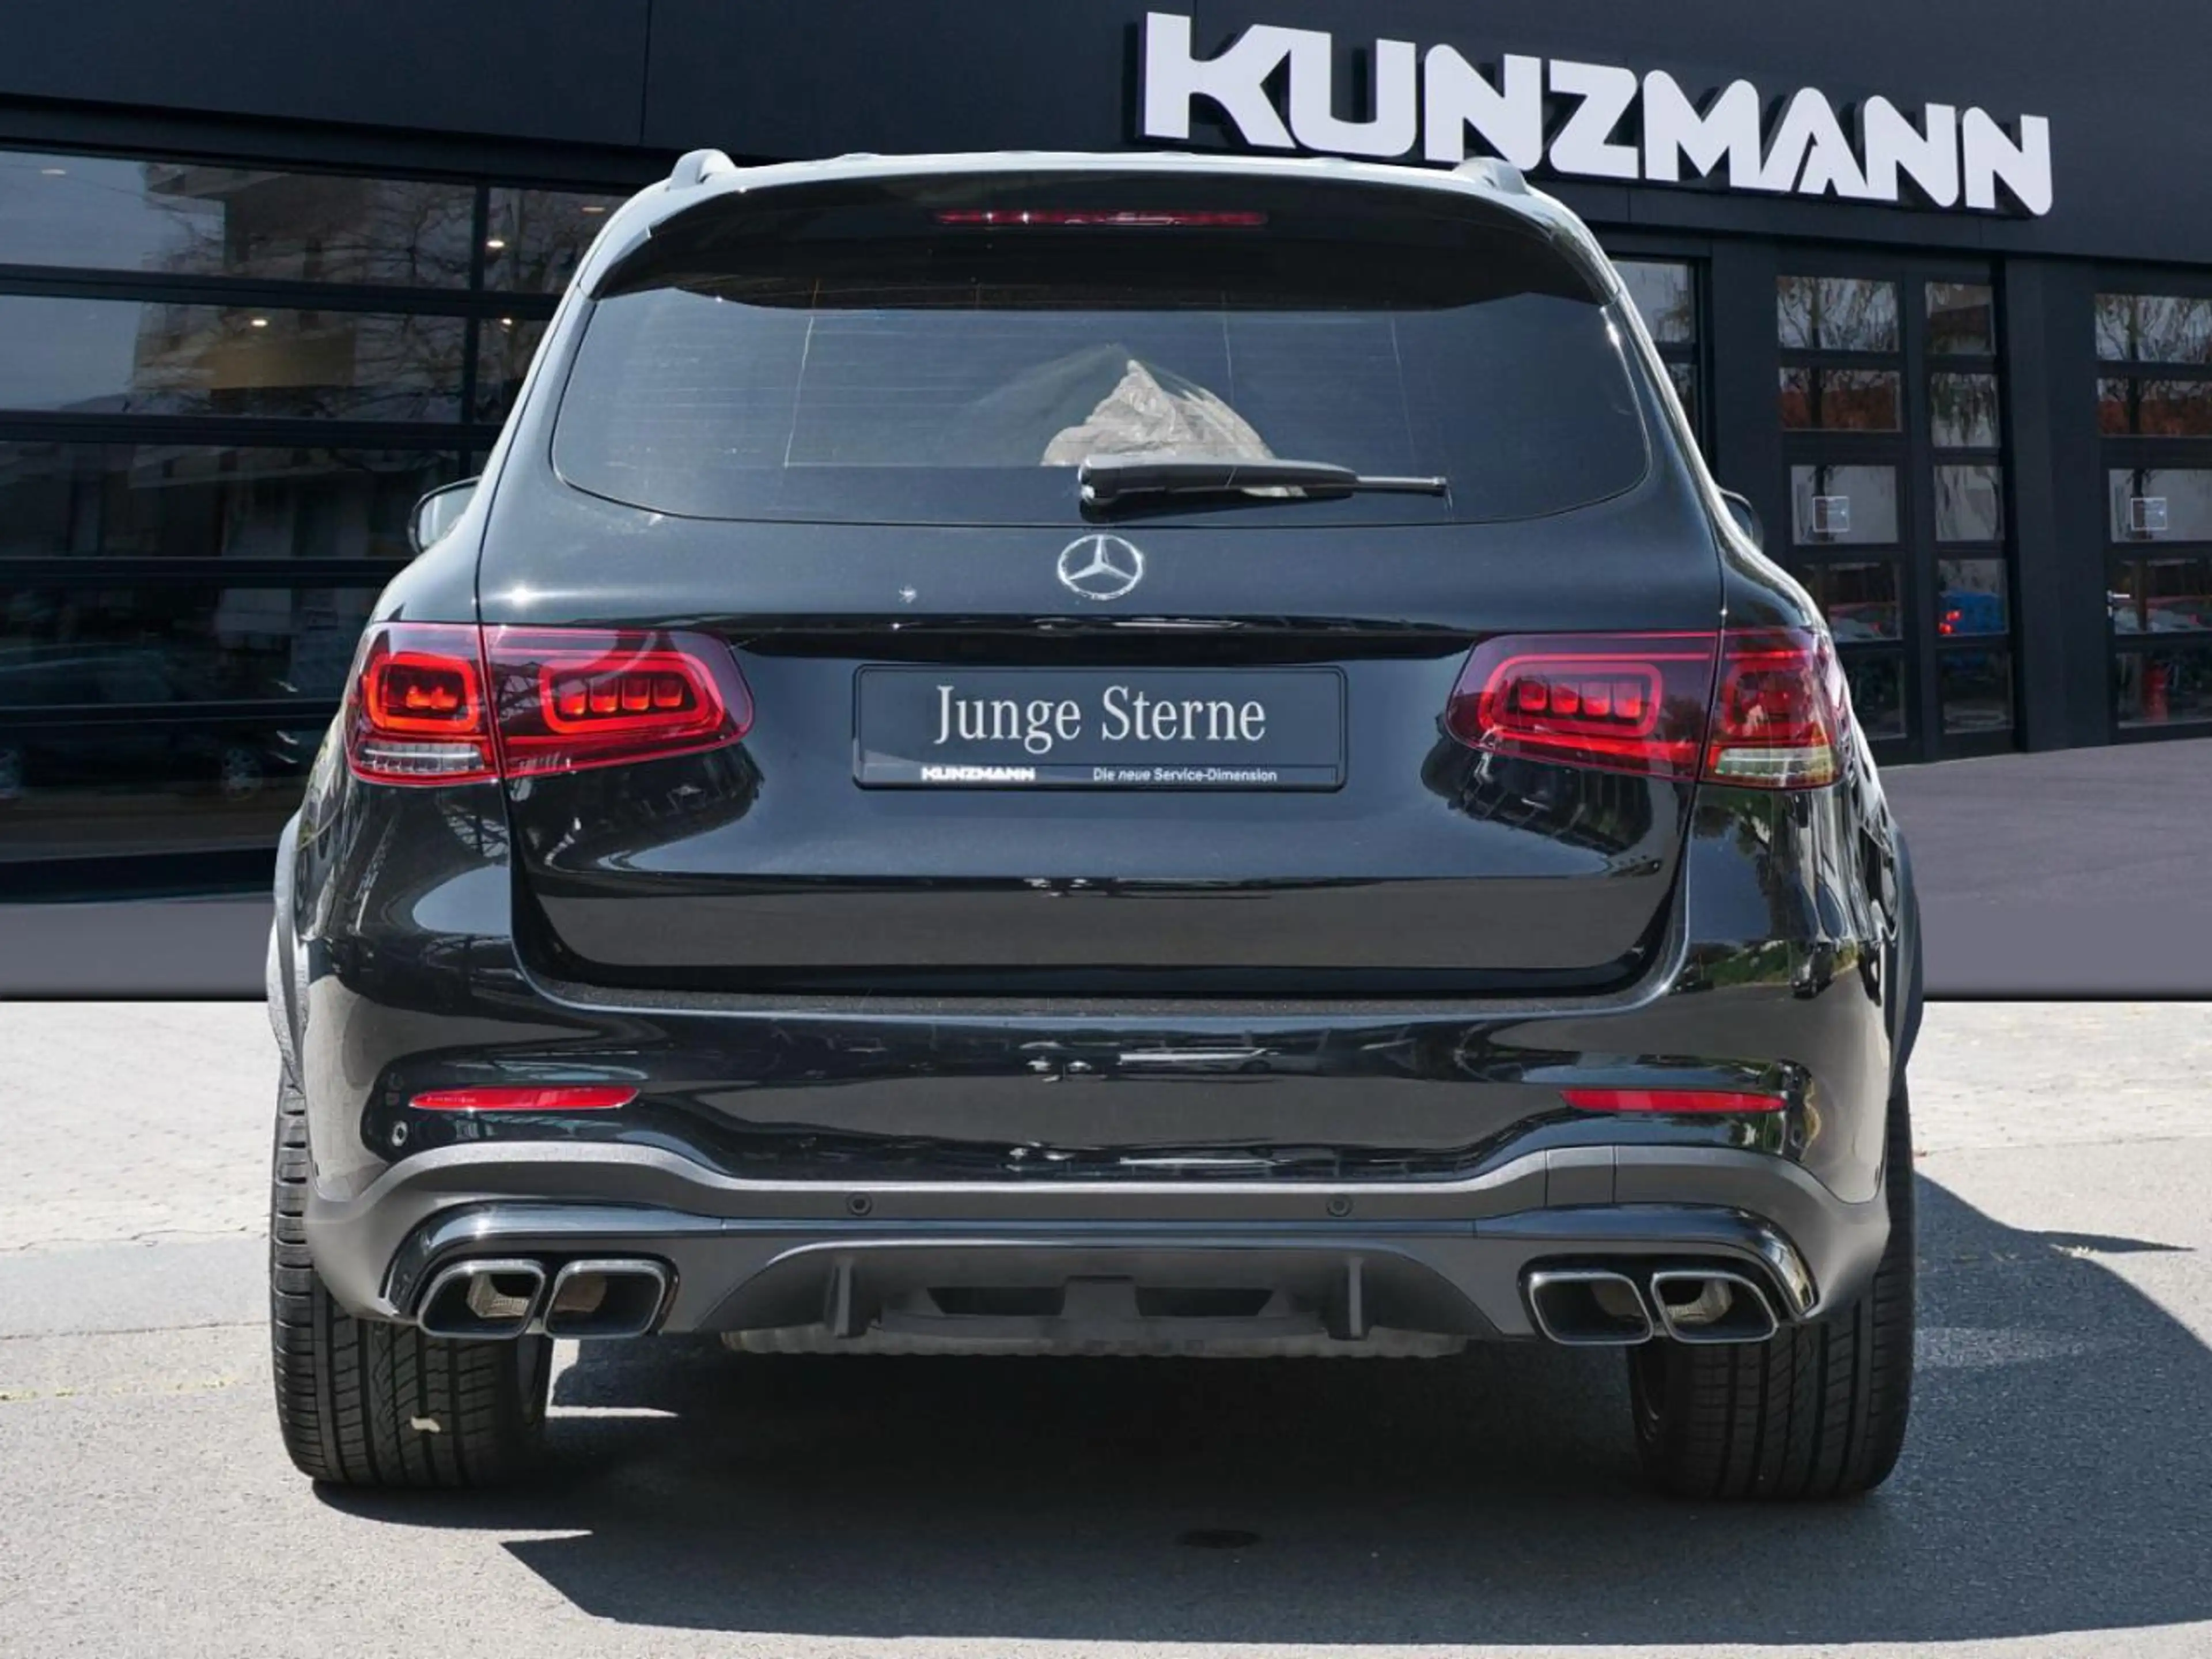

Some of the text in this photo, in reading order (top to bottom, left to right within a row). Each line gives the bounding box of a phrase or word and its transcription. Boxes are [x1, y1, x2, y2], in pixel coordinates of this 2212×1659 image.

[1144, 12, 2052, 216] KUNZMANN
[934, 685, 1266, 755] Junge Sterne
[921, 766, 1036, 782] KUNZMANN
[1093, 767, 1278, 782] Die neue Service-Dimension
